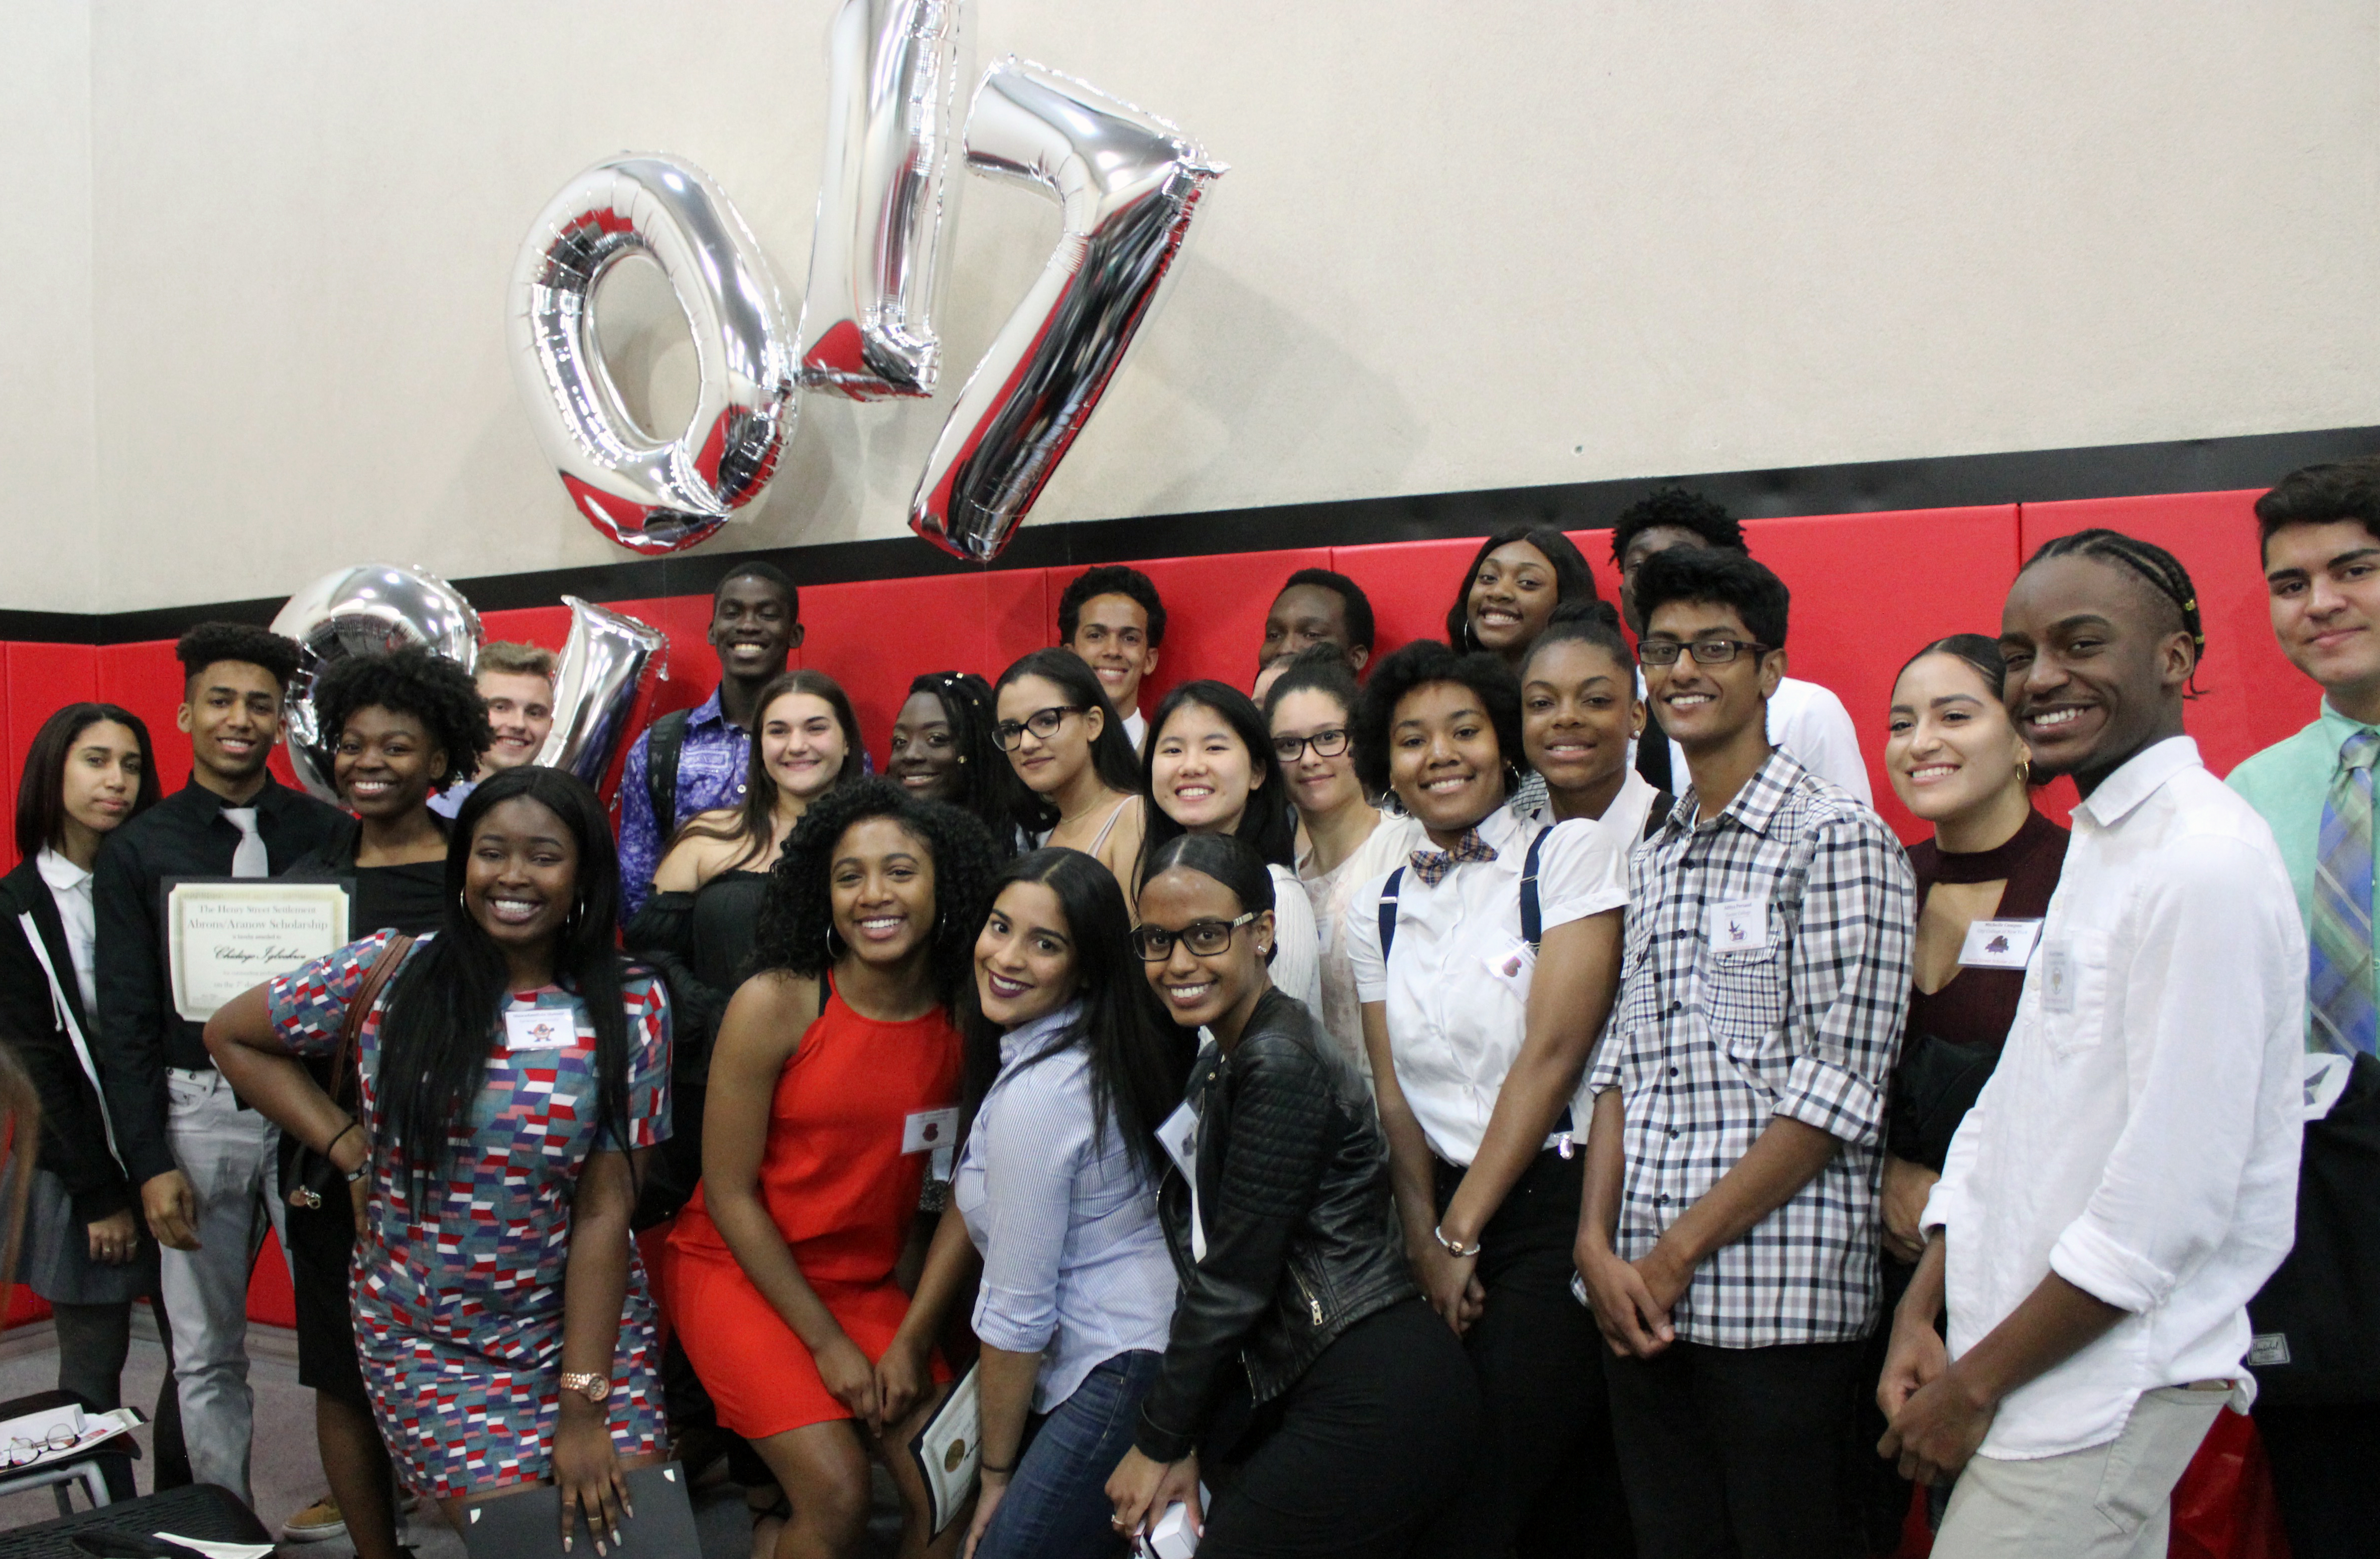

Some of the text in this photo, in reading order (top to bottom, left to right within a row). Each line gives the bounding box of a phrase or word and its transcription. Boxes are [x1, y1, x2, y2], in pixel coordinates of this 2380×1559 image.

[200, 904, 316, 915] The Henry Street Settlement
[270, 919, 329, 931] Scholarship
